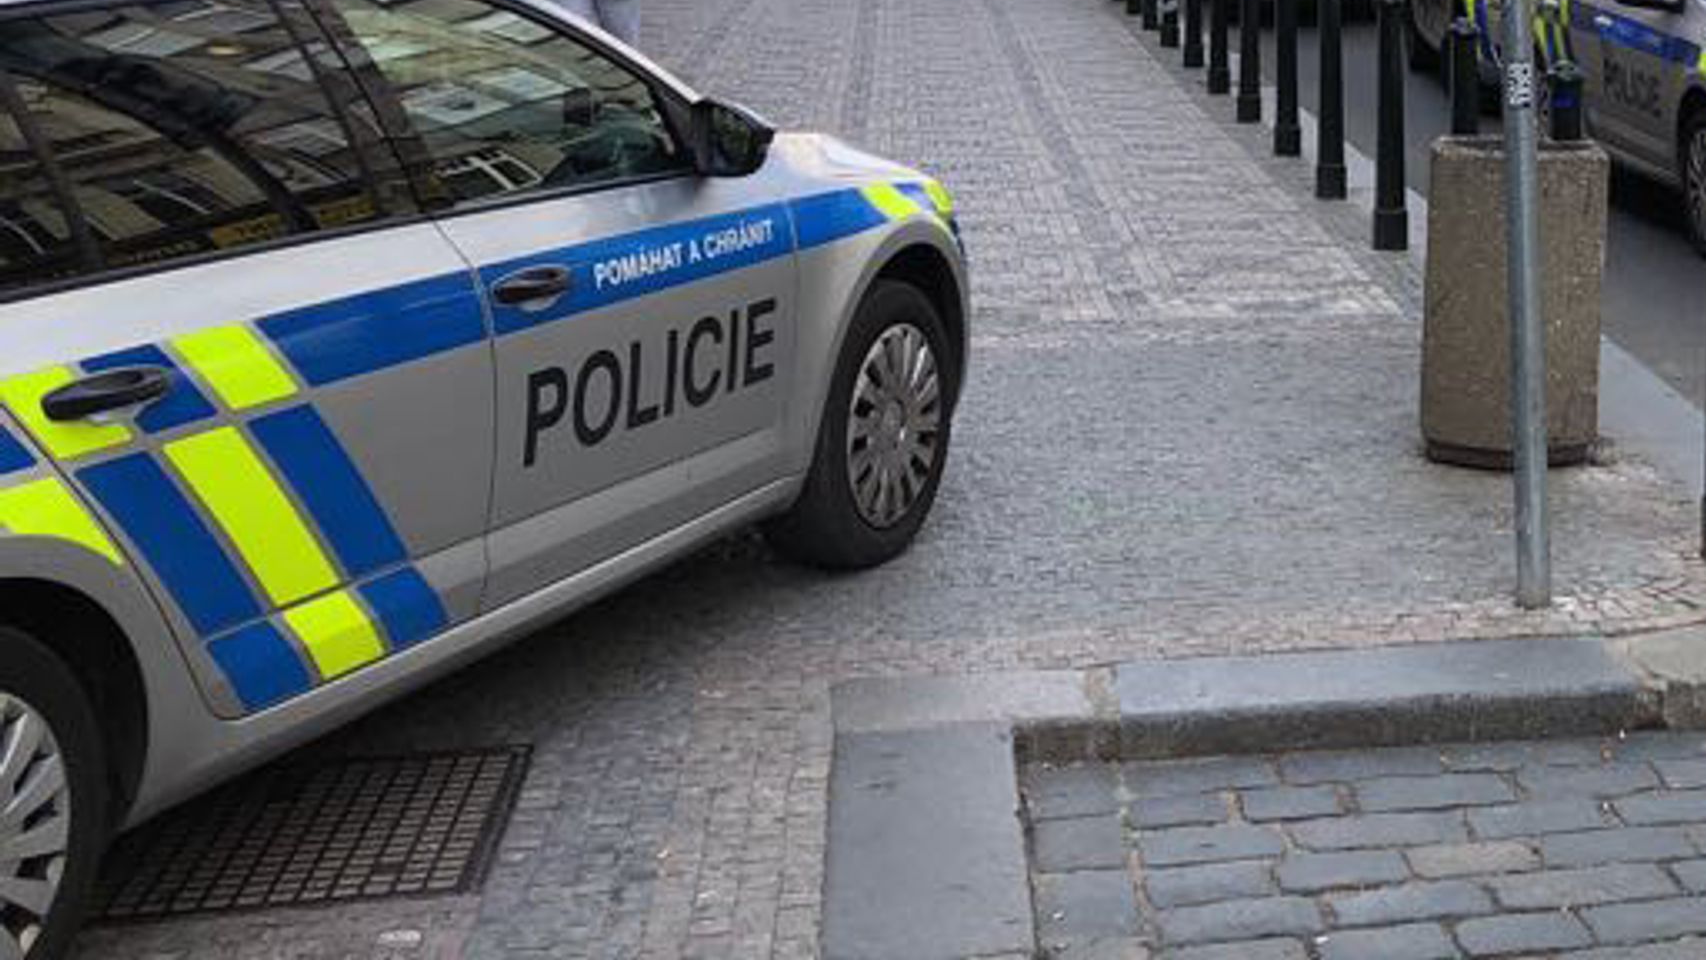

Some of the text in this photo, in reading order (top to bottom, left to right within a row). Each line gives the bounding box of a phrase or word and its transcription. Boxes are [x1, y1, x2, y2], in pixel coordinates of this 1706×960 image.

[593, 218, 774, 290] POMÁHAT A CHRÁNIT
[523, 297, 777, 468] POLICIE
